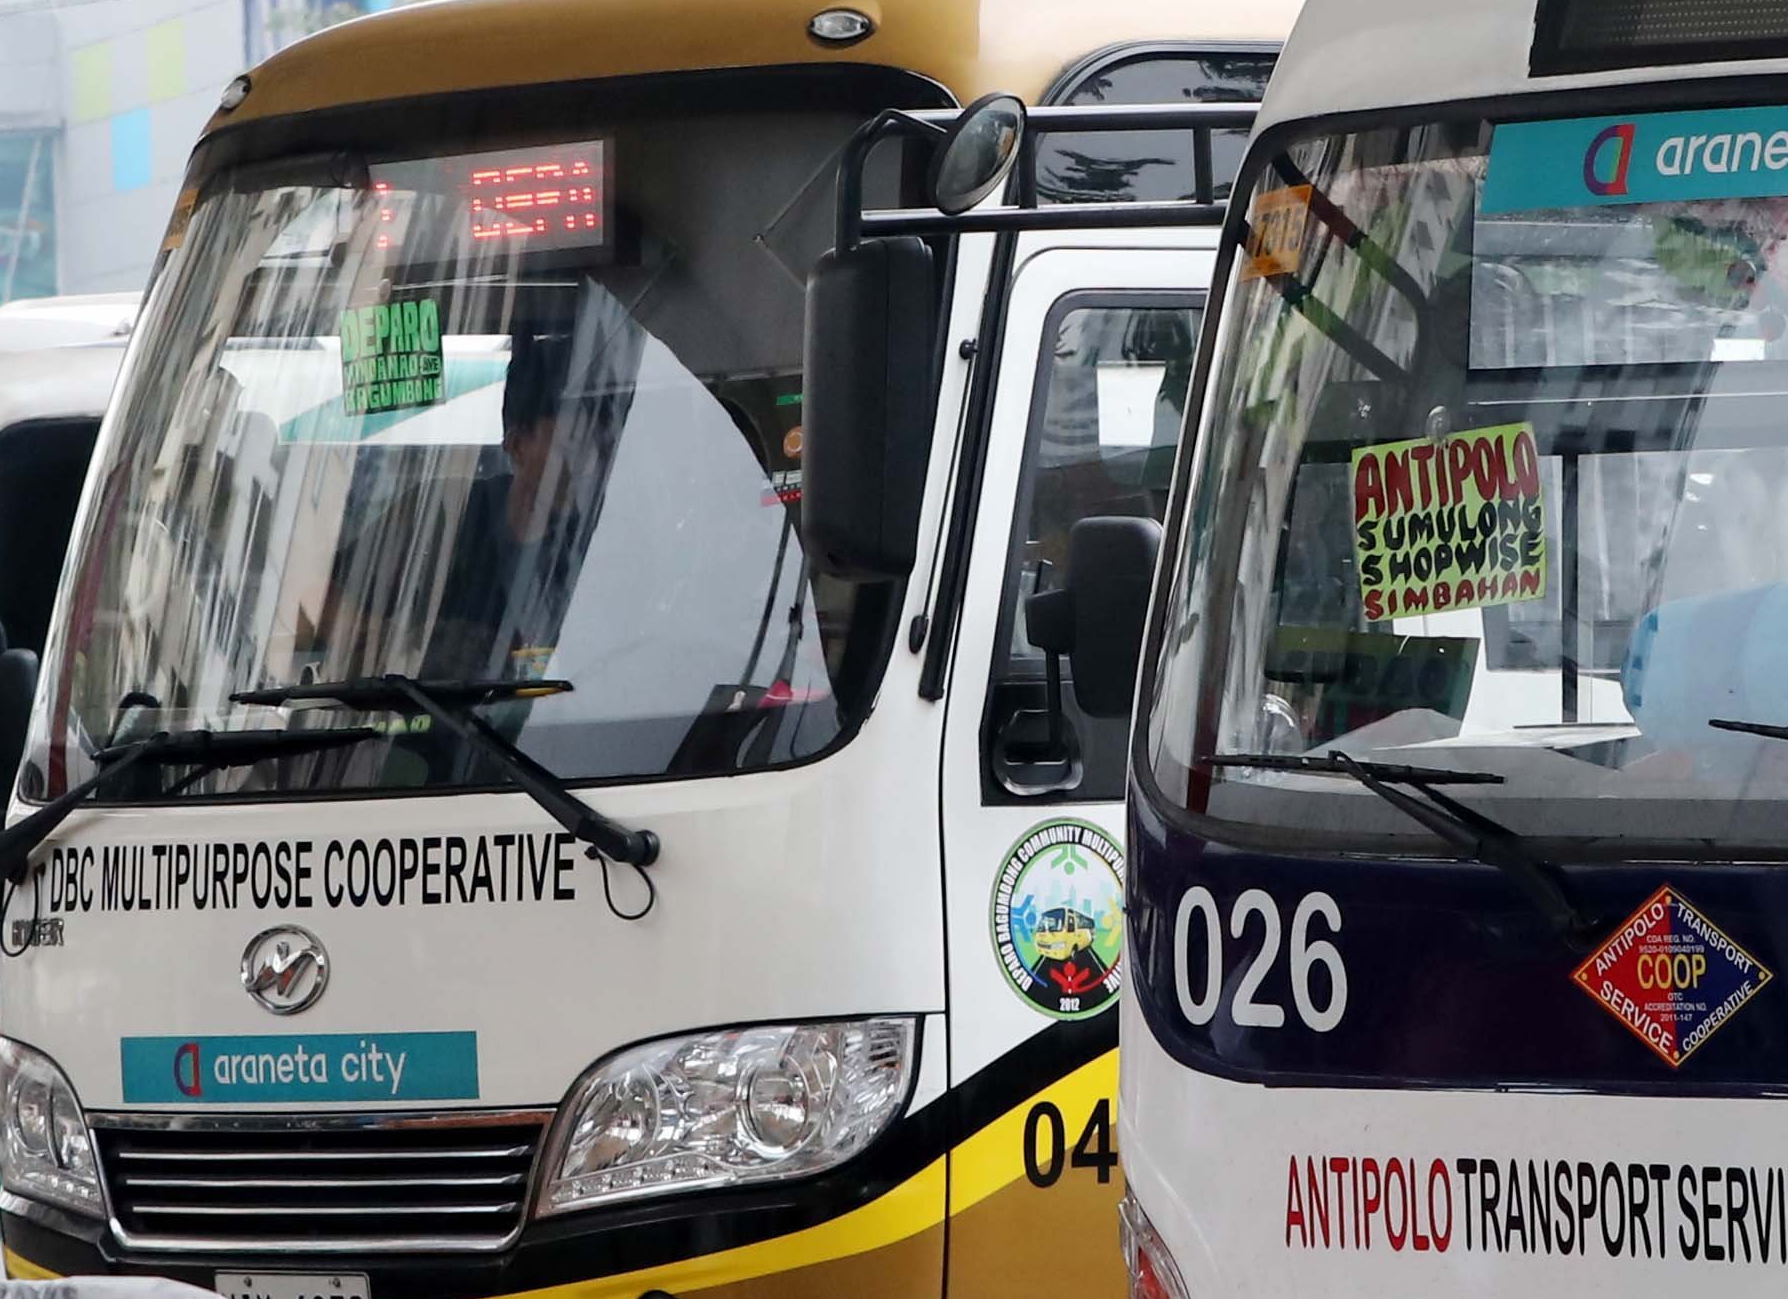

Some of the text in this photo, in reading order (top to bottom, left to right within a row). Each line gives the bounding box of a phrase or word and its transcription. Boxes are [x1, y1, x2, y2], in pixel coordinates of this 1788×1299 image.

[340, 298, 440, 363] DEPARO
[1354, 431, 1540, 525] ANTIPOLO
[1357, 493, 1542, 551] SUMULONG
[1361, 531, 1544, 587] SHOPWISE
[1364, 567, 1541, 621] SIMBAHAN
[50, 830, 576, 913] DBC MULTIPURPOSE COOPERATIVE
[995, 825, 1124, 992] DEPARO BAGUMBONG COMMUNITY MULTIPU
[1595, 902, 1754, 977] ANTIPOLO TRANSPORT
[1172, 887, 1348, 1034] 026
[1637, 953, 1707, 990] COOP
[1059, 997, 1081, 1012] 2012
[1600, 980, 1754, 1054] SERVICE COOPERATIVE
[214, 1039, 406, 1095] araneta city
[1285, 1154, 1453, 1254] ANTIPOLO
[1455, 1157, 1671, 1258] TRANSPORT
